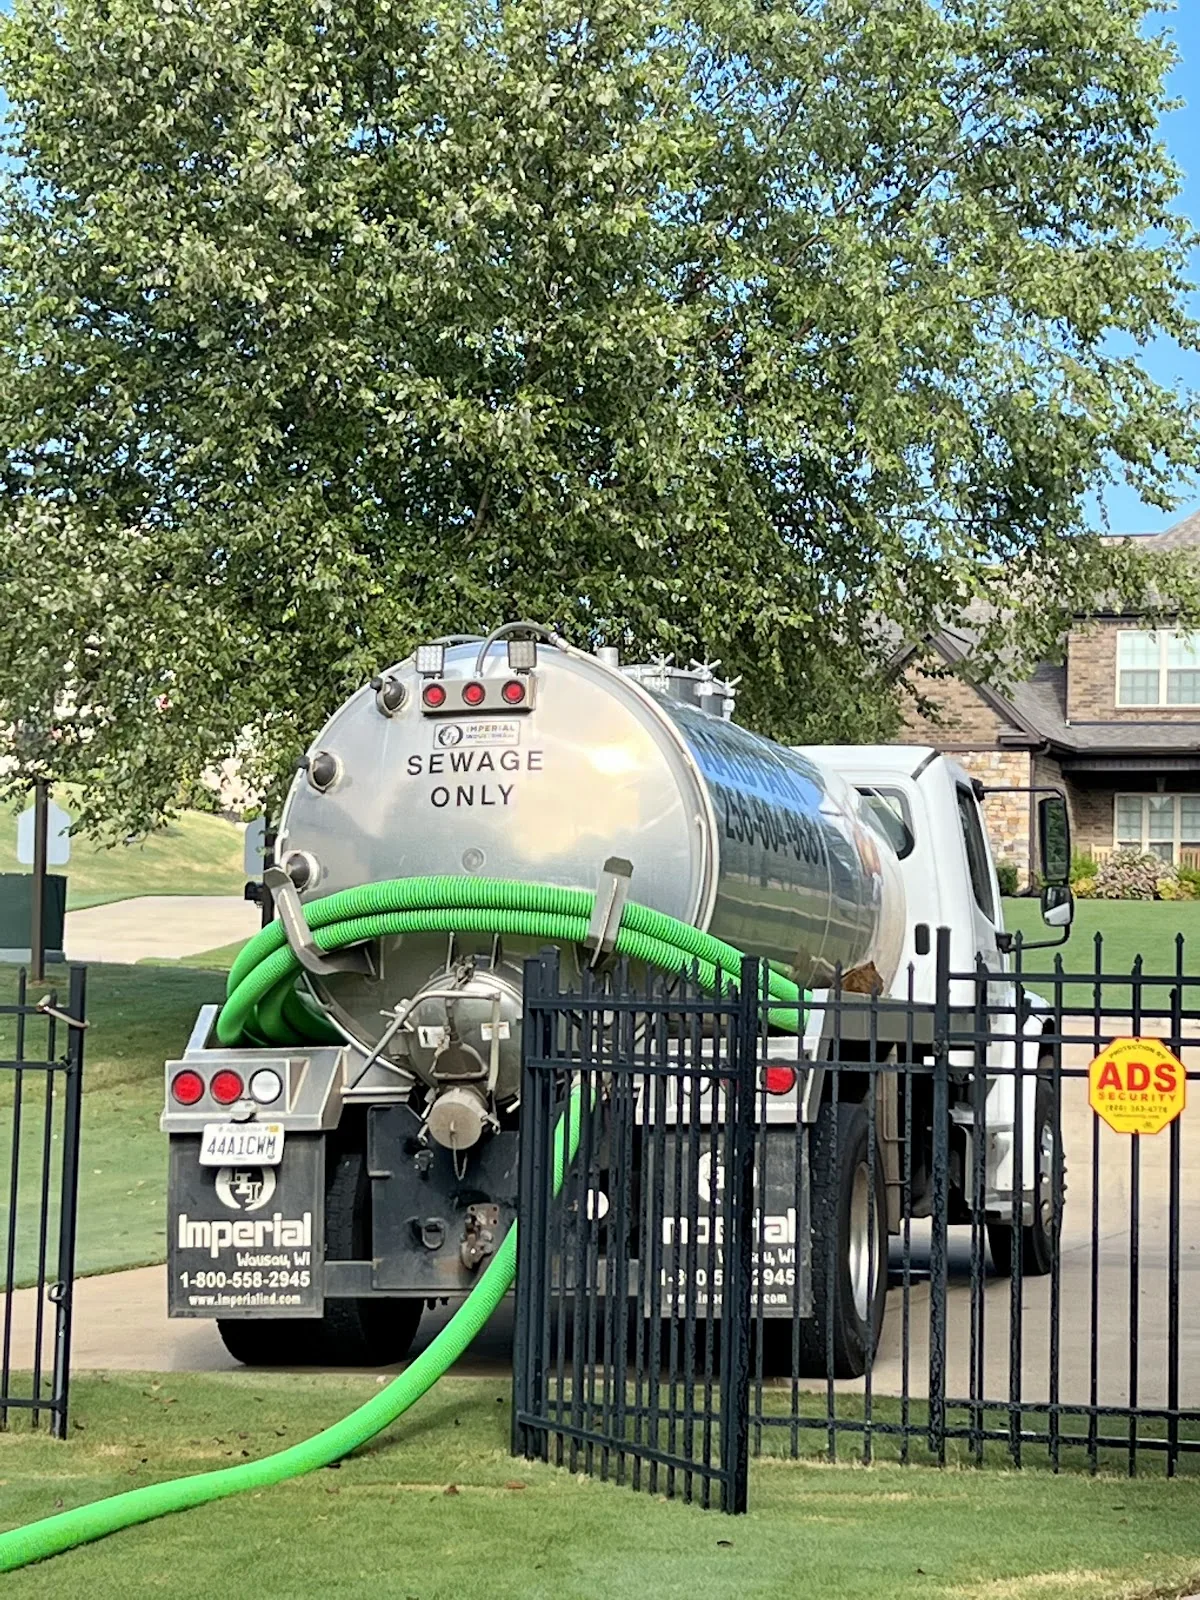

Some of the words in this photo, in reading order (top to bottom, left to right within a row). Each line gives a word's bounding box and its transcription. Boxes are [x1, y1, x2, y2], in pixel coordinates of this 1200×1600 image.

[466, 724, 515, 732] IMPERIAL
[407, 750, 543, 775] SEWAGE
[431, 784, 515, 807] ONLY
[1097, 1062, 1176, 1092] ADS
[1098, 1092, 1176, 1102] SECURITY
[207, 1136, 276, 1155] 44A1CWM
[179, 1213, 311, 1258] Imperial
[236, 1252, 291, 1268] Wausau,
[294, 1252, 310, 1266] WI
[180, 1271, 310, 1289] 1-800-558-2945
[188, 1293, 300, 1308] www.imperialind.com
